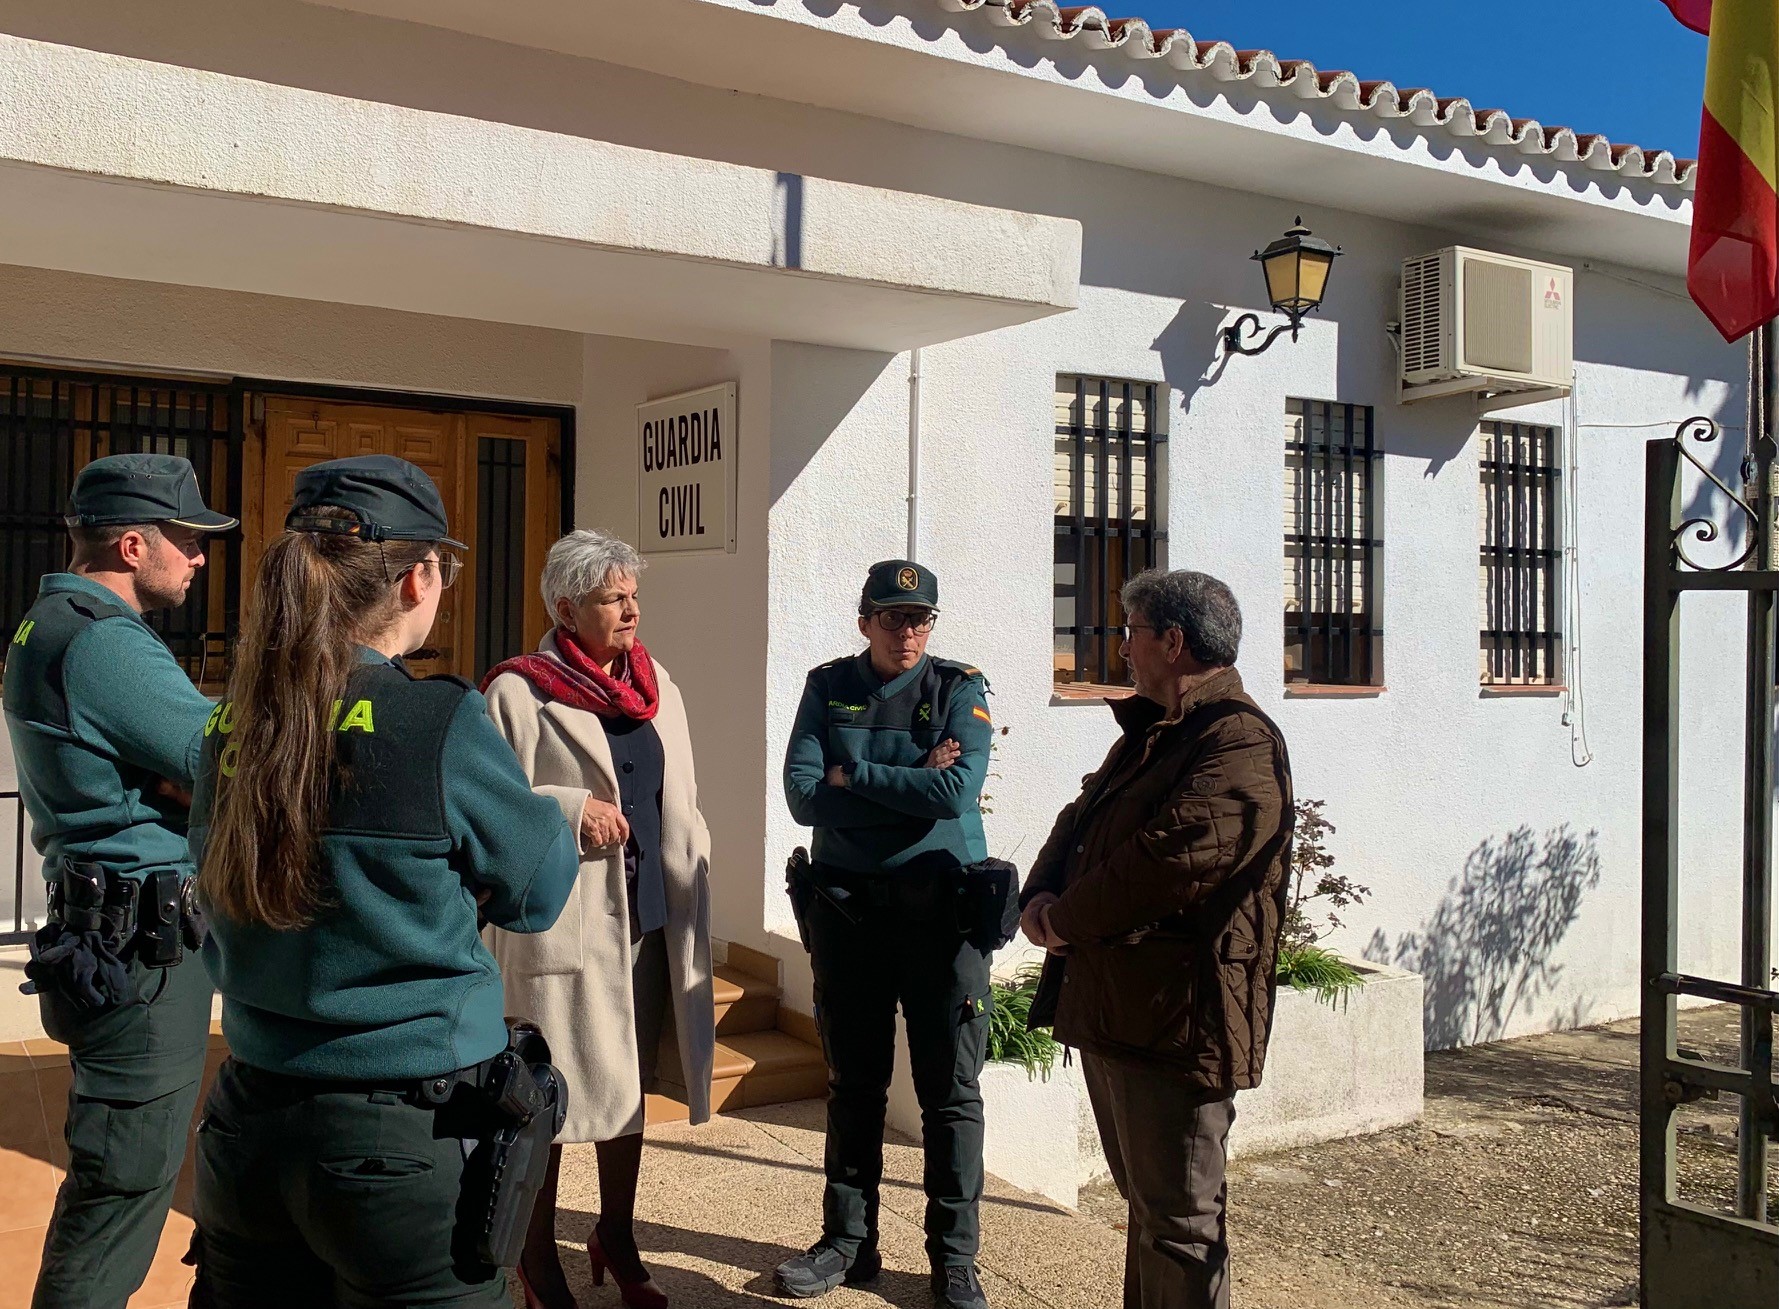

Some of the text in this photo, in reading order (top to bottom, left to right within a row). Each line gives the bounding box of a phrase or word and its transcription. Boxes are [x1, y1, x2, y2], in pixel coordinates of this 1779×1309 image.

[643, 408, 721, 472] GUARDIA
[659, 483, 704, 538] CIVIL
[204, 699, 375, 737] GUIA
